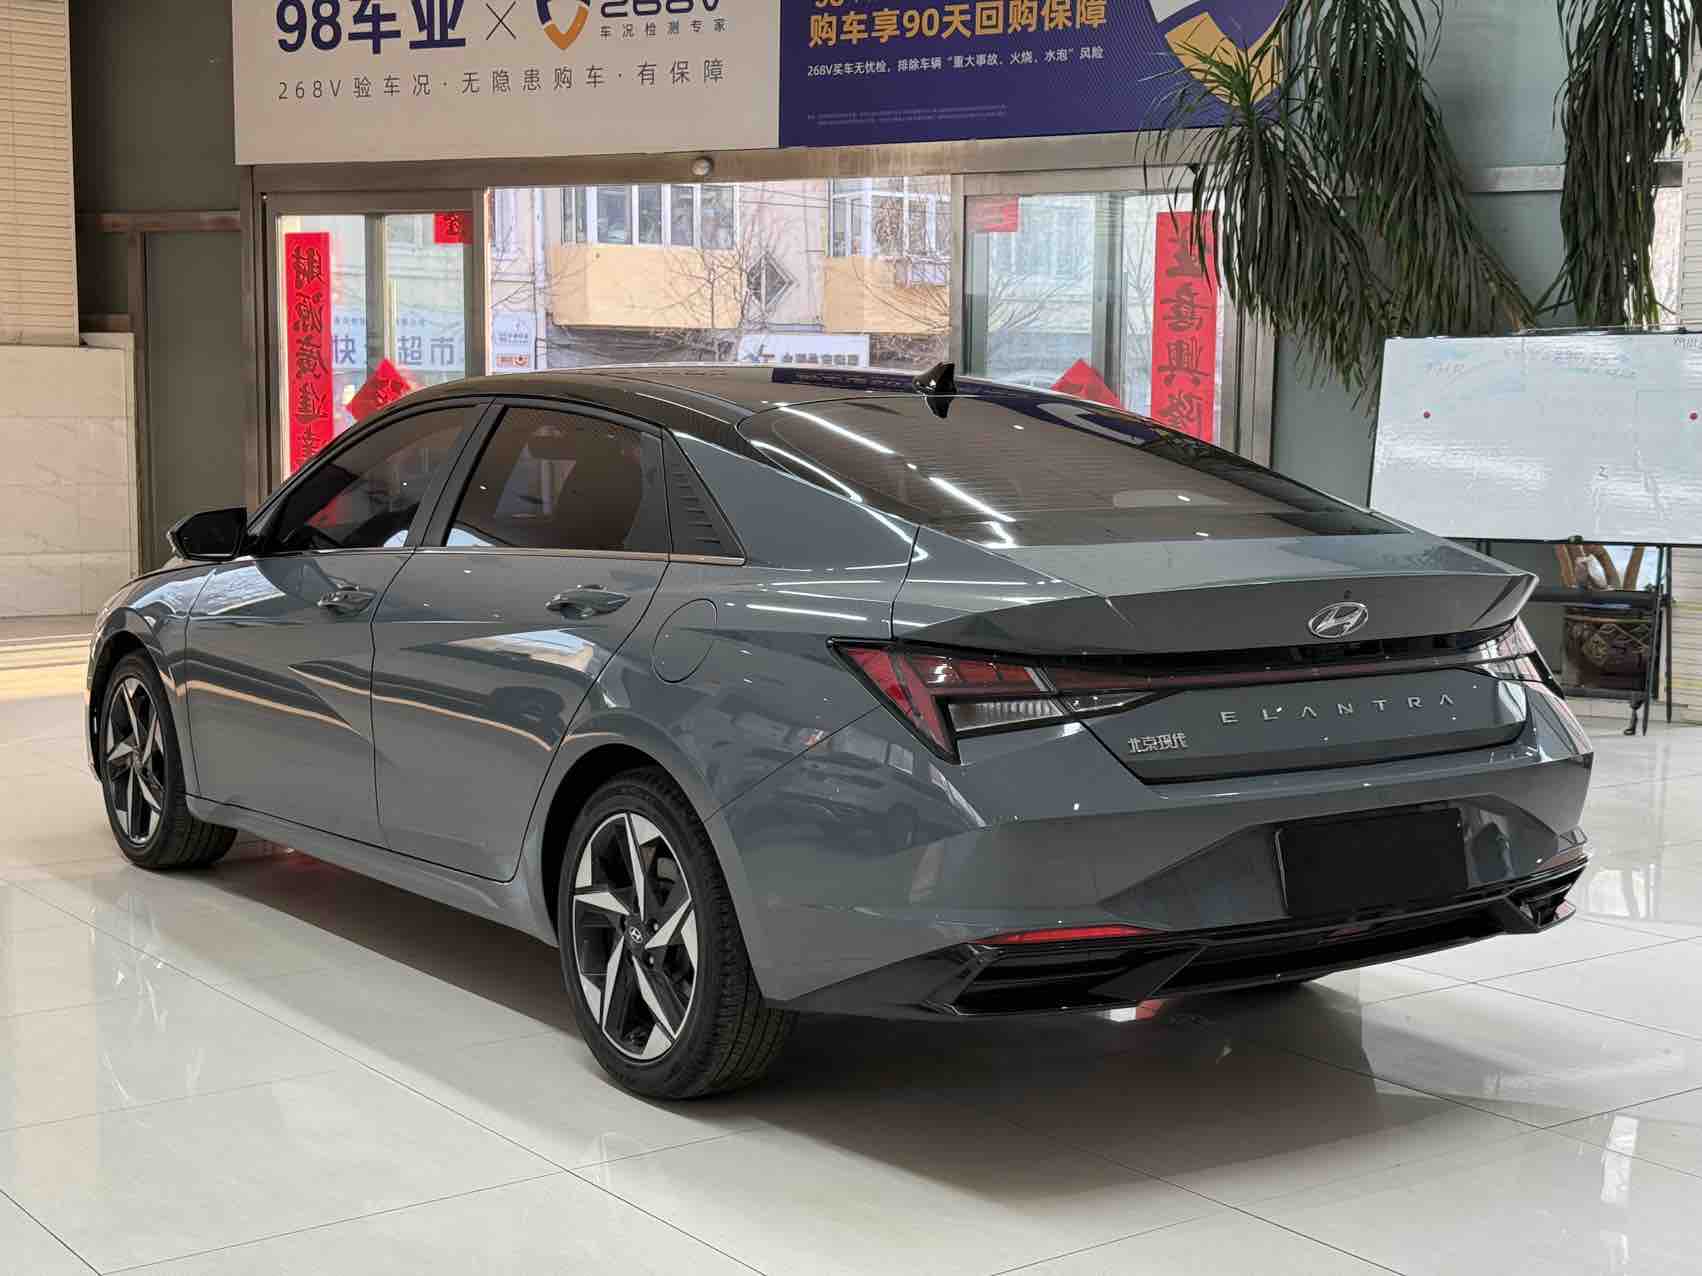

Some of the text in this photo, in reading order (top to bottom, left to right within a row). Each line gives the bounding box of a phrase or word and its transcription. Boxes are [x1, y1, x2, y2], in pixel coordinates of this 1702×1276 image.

[276, 0, 467, 54] 98车业
[600, 18, 728, 39] 车况检测专家
[808, 0, 1107, 48] 购车享90天回购保障
[1220, 693, 1454, 725] ELANTRA
[1128, 732, 1188, 753] 北京现代
